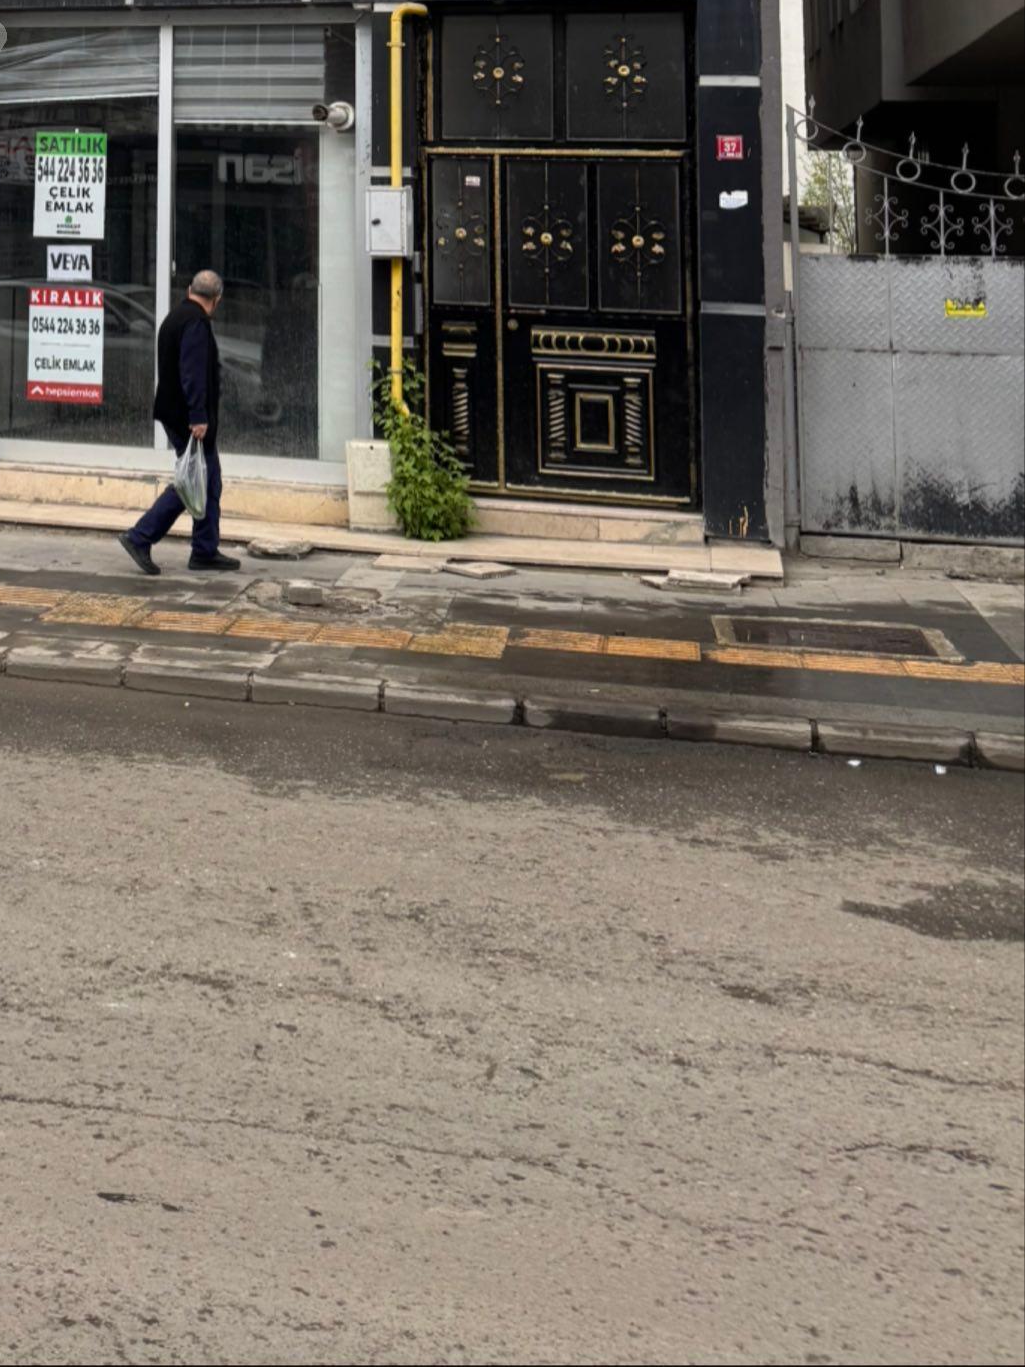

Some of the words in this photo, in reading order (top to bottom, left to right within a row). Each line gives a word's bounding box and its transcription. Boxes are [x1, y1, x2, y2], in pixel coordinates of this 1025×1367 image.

[723, 141, 737, 152] 37
[57, 155, 75, 182] 224
[78, 156, 89, 183] 36
[92, 157, 104, 183] 36
[49, 184, 91, 200] ÇELİK
[45, 200, 94, 214] EMLAK
[50, 252, 90, 271] VEYA
[32, 316, 55, 334] 0544
[57, 317, 74, 334] 224
[75, 318, 87, 335] 36
[88, 319, 101, 336] 36
[34, 355, 62, 371] ÇELİK
[63, 358, 96, 373] EMLAK
